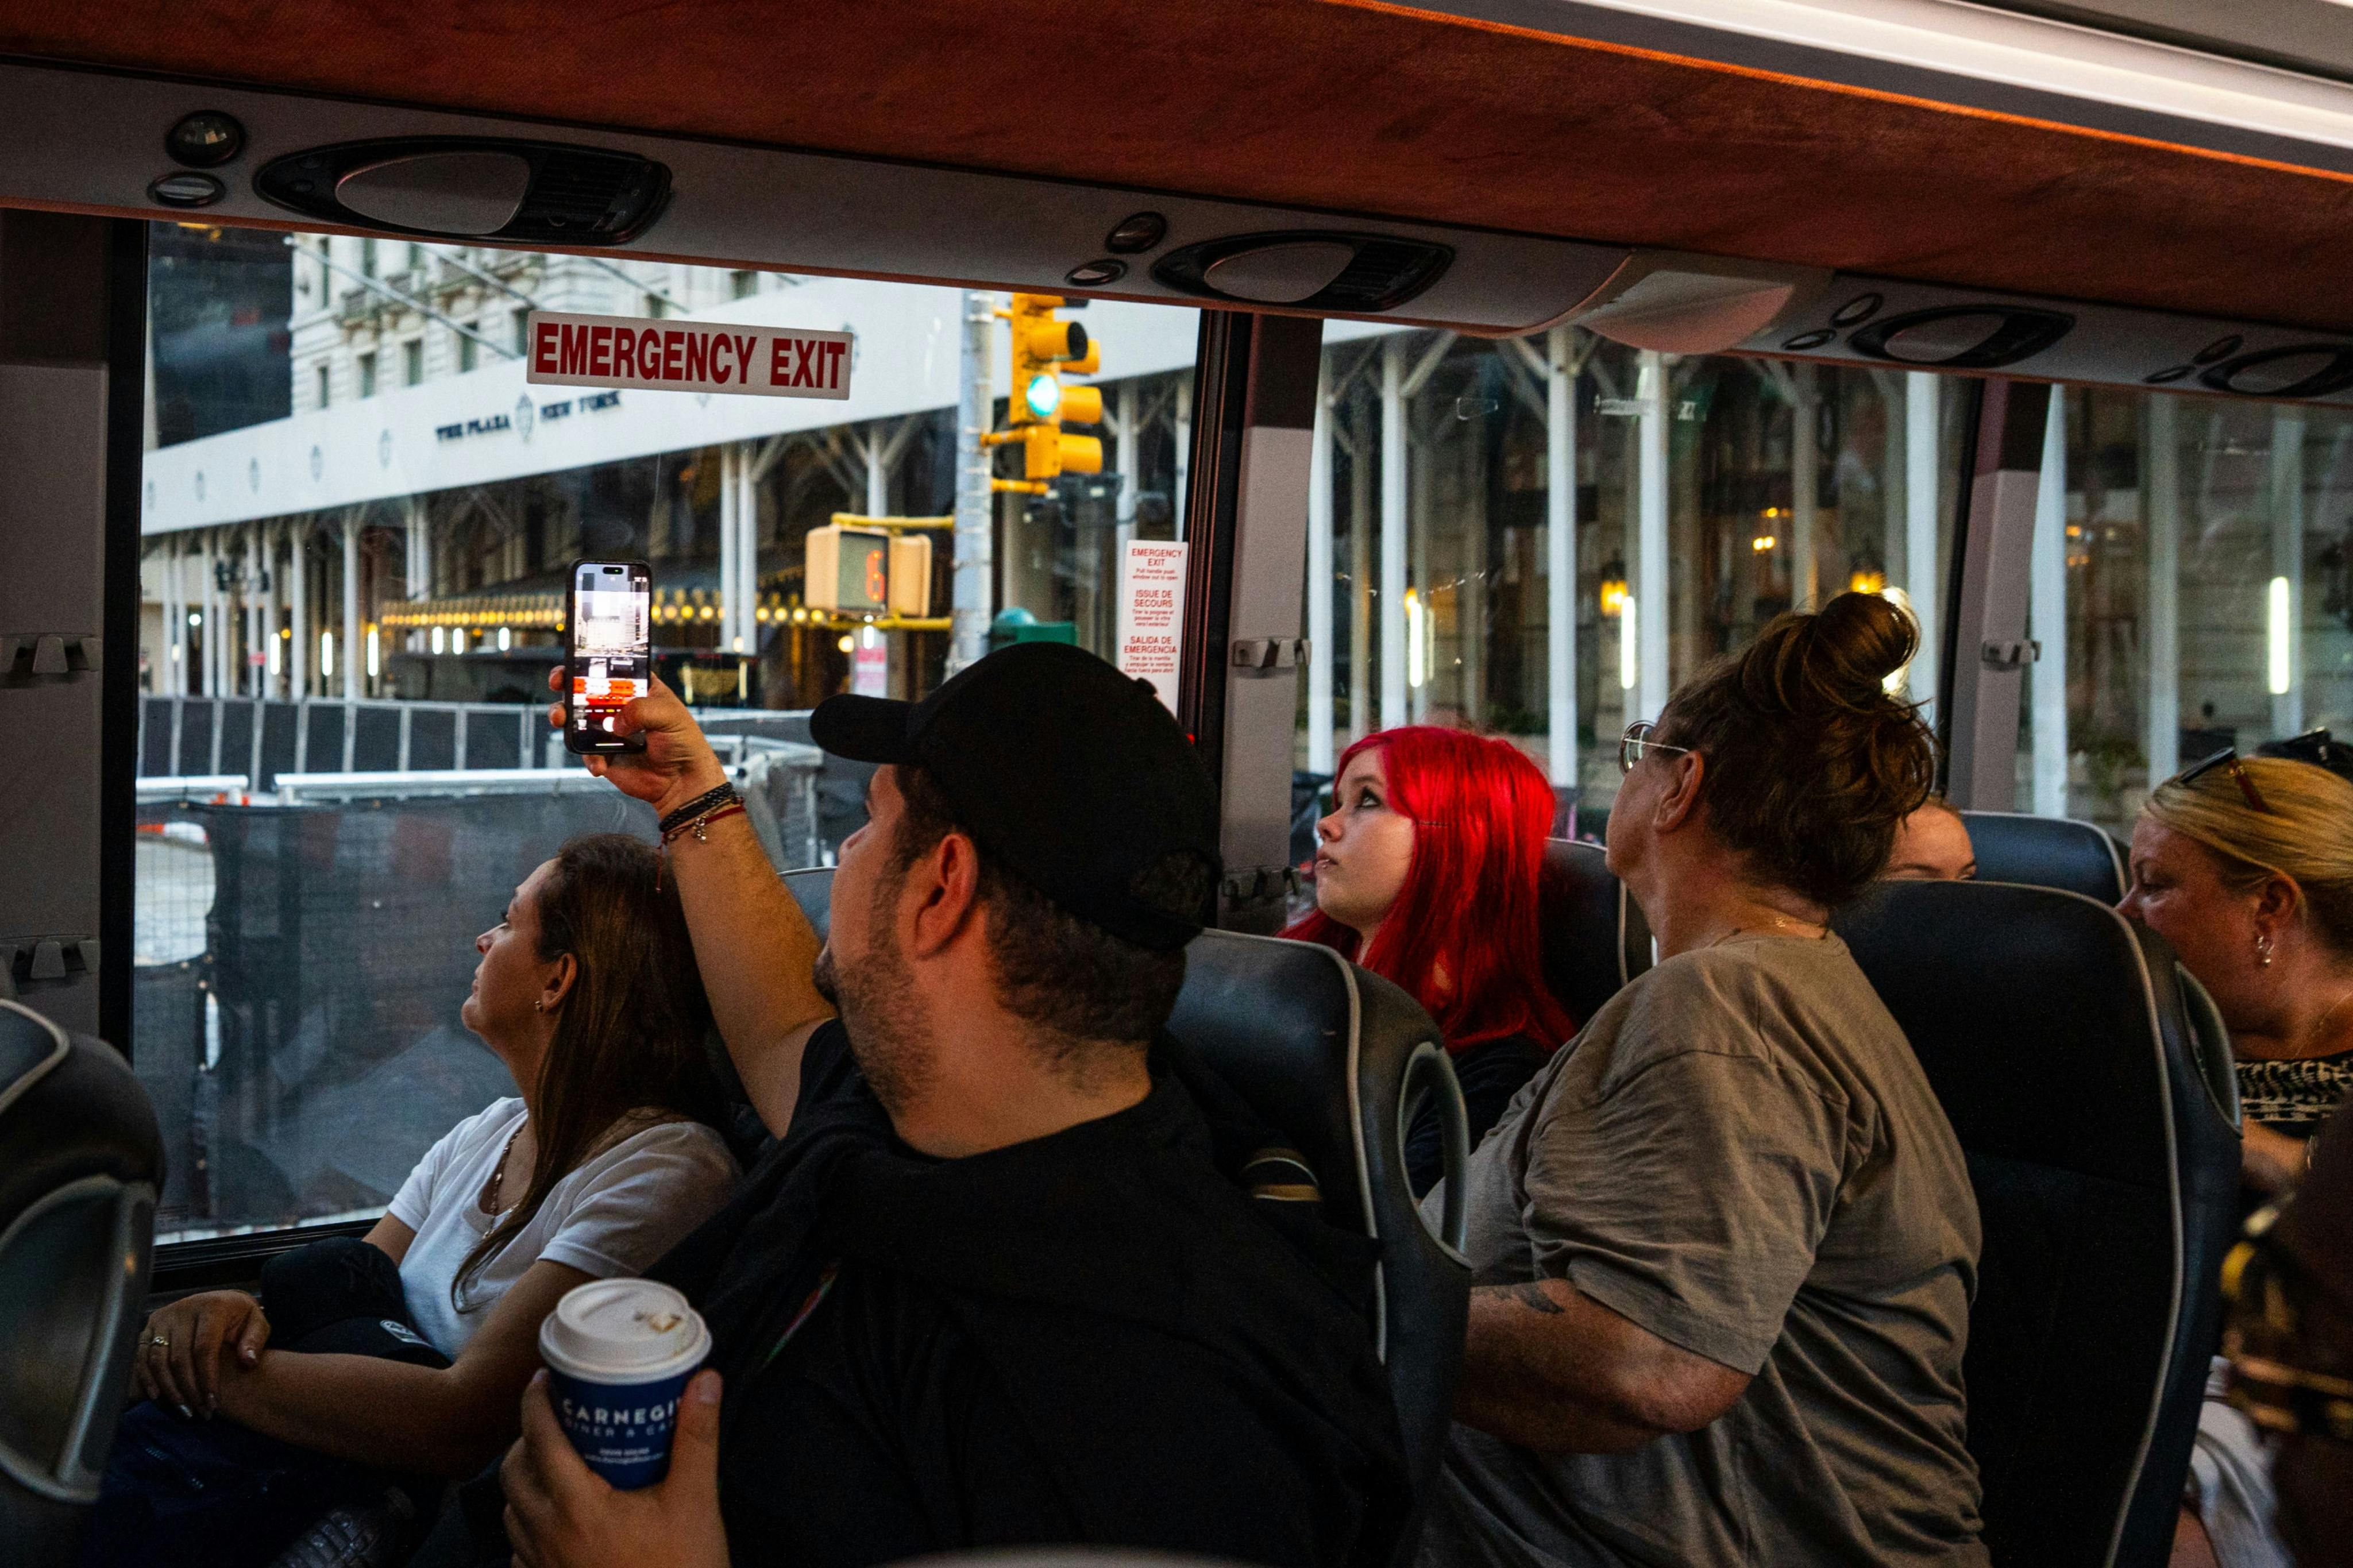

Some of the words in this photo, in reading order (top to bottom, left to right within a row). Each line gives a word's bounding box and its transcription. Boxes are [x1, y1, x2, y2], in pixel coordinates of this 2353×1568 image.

[535, 322, 757, 384] EMERGENCY
[770, 337, 846, 389] EXIT
[437, 424, 462, 442] THE
[468, 414, 510, 435] PLAZA
[540, 401, 572, 422] NEW
[578, 390, 620, 413] YORK
[1132, 549, 1182, 557] EMERGENCY
[866, 549, 885, 602] 6
[1136, 590, 1159, 598] ISSUE
[1162, 590, 1172, 598] DE
[1134, 599, 1173, 607] SECOURS
[1130, 636, 1159, 644] SALIDA
[1162, 636, 1172, 644] DE
[1124, 645, 1177, 654] EMERGENCIA
